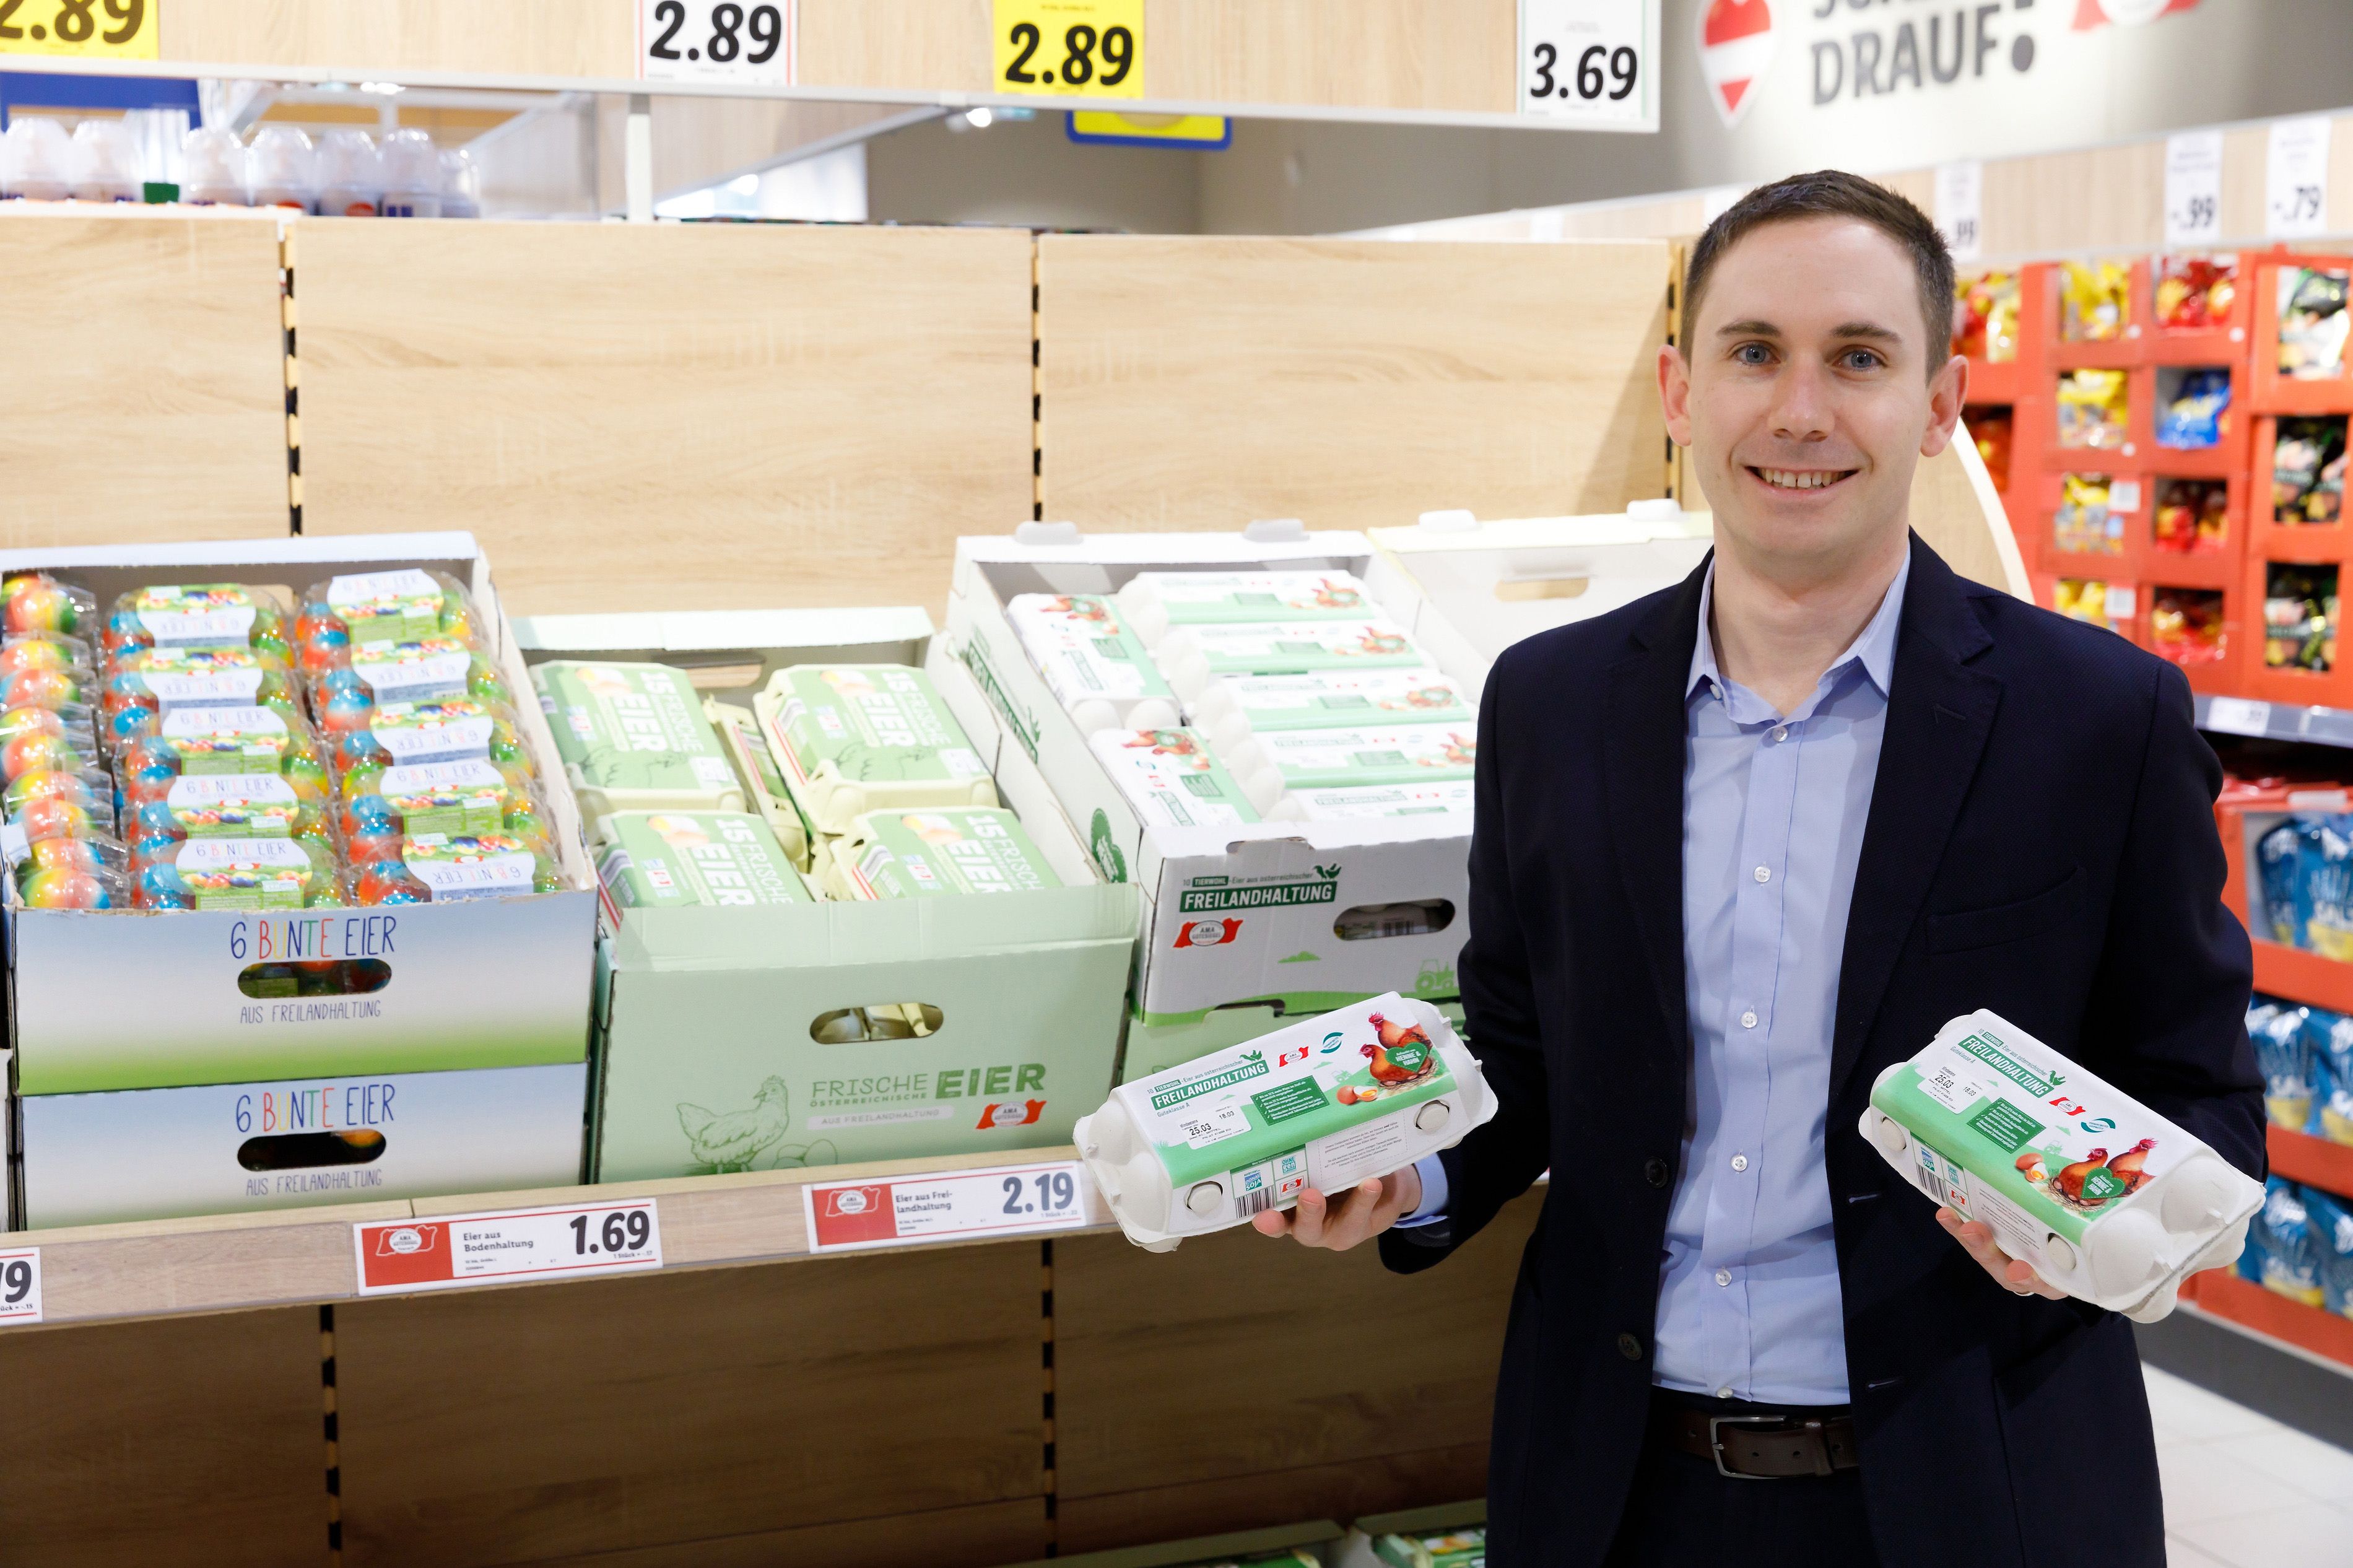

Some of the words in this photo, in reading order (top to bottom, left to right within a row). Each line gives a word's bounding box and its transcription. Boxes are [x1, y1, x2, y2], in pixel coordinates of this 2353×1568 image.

[650, 1, 781, 63] 2.89
[1006, 23, 1133, 85] 2.89
[1531, 43, 1637, 100] 3.69
[1185, 884, 1332, 910] FREILANDHALTUNG
[231, 921, 246, 959] 6
[259, 918, 334, 959] BUNTE
[346, 916, 396, 956] EIER
[240, 1006, 264, 1024] AUS
[272, 1000, 381, 1022] FREILANDHALTUNG
[1963, 1037, 2049, 1095] FREILANDHALTUNG
[812, 1073, 929, 1098] FRISCHE
[935, 1063, 1046, 1099] EIER
[1155, 1063, 1266, 1107] FREILANDHALTUNG
[1935, 1075, 1954, 1088] 25.03
[1963, 1086, 1977, 1097] 18.03
[236, 1095, 251, 1133] 6
[264, 1087, 335, 1131] BUNTE
[346, 1084, 396, 1125] EIER
[810, 1092, 928, 1107] ÖSTERREICHISCHE
[821, 1116, 841, 1125] AUS
[845, 1109, 940, 1123] FREILANDHALTUNG
[1219, 1110, 1235, 1120] 18.03
[1190, 1123, 1211, 1136] 25.03
[246, 1178, 269, 1196] AUS
[276, 1169, 383, 1193] FREILANDHALTUNG
[1003, 1172, 1074, 1214] 2.19
[1246, 1178, 1261, 1191] SOJA
[896, 1195, 912, 1203] Eier
[933, 1190, 953, 1200] Frei-
[897, 1202, 951, 1214] landhaltung
[464, 1233, 482, 1241] Eier
[570, 1211, 650, 1255] 1.69
[464, 1240, 534, 1253] Bodenhaltung
[0, 1261, 32, 1303] 9
